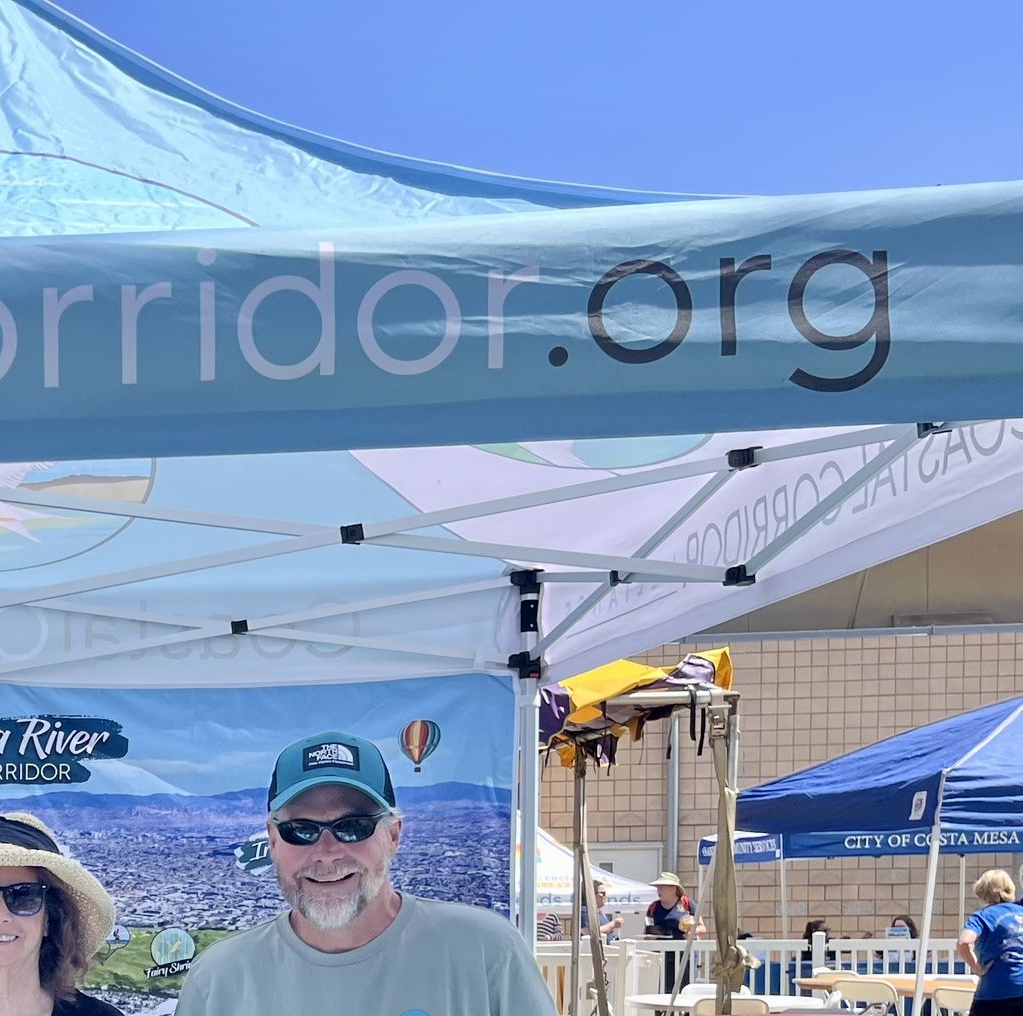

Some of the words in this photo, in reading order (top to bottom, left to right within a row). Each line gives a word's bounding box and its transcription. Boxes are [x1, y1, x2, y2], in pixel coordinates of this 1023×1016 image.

[15, 718, 111, 761] River
[321, 743, 338, 751] THE
[308, 749, 338, 759] NORTH
[843, 834, 884, 849] CITY
[887, 833, 911, 848] OF
[971, 831, 1020, 845] MESA
[145, 967, 169, 979] Fairy
[169, 960, 192, 975] Shri
